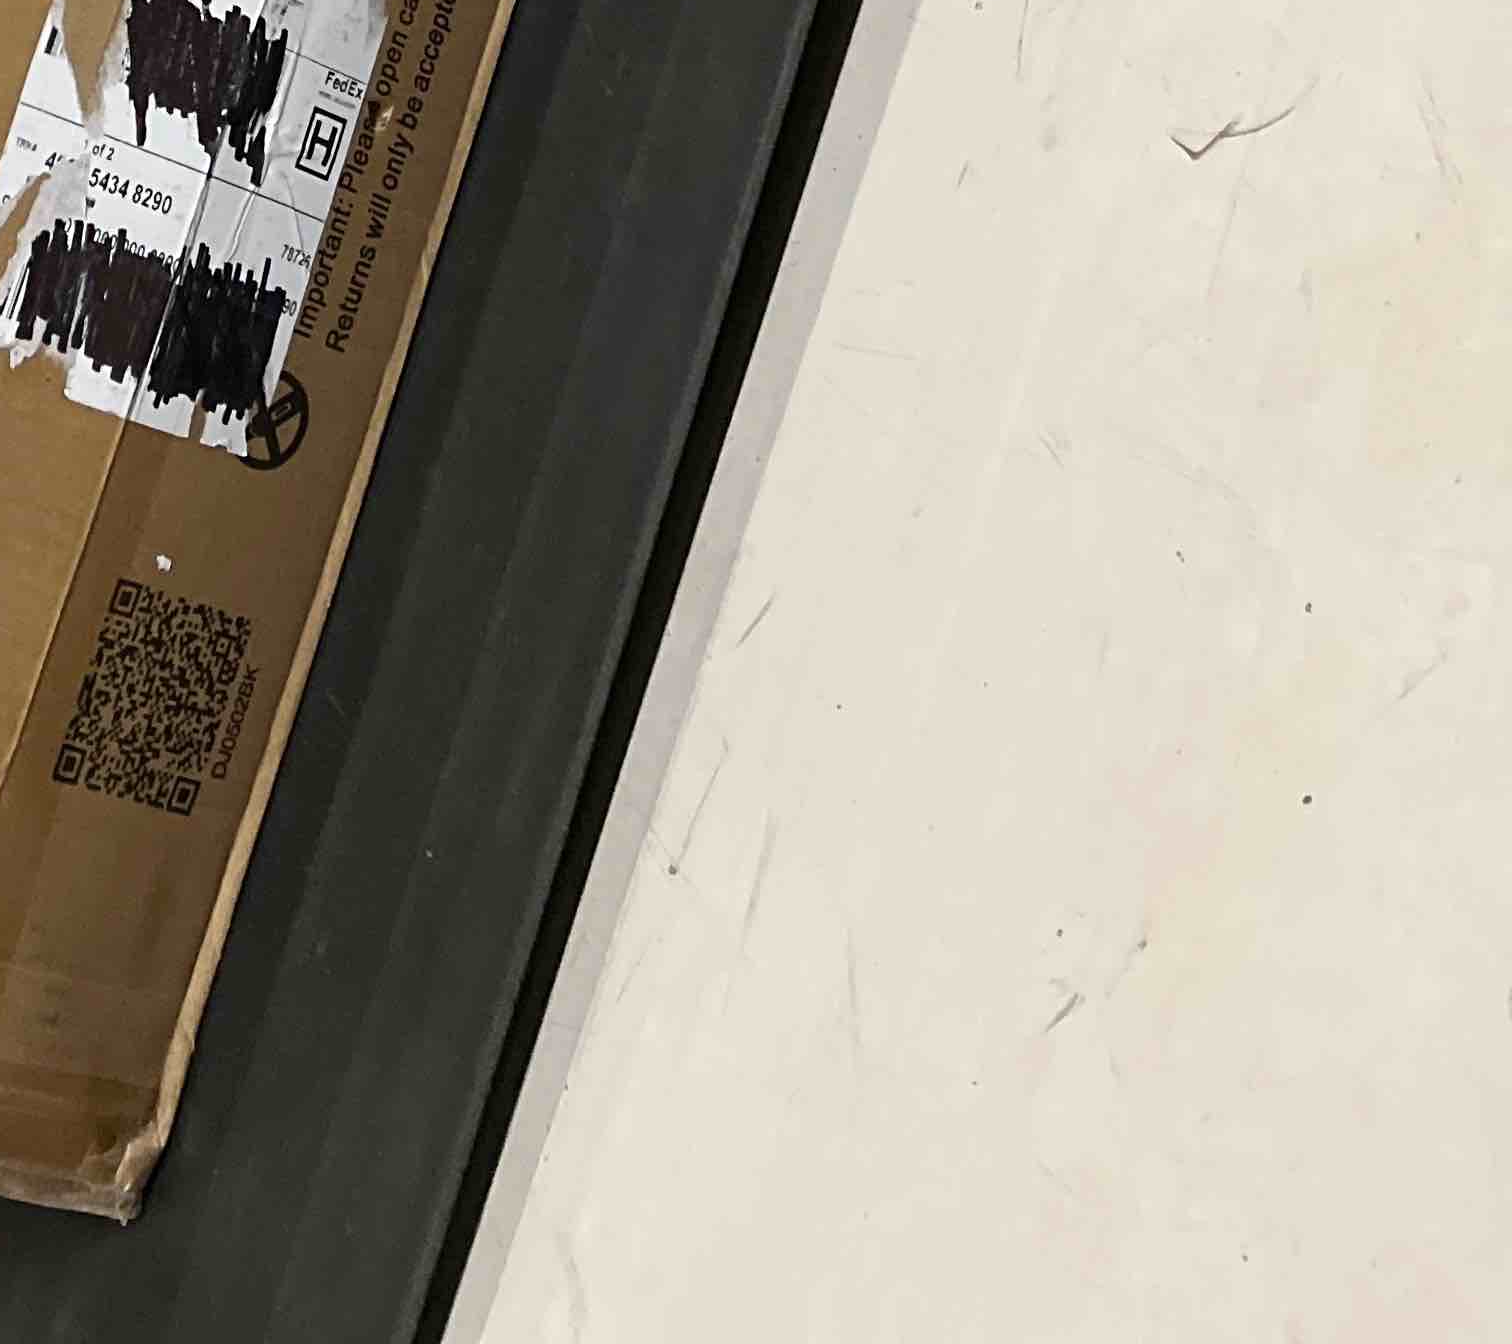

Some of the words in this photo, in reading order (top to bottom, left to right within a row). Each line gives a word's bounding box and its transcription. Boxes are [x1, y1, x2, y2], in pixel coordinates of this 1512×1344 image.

[324, 70, 365, 100] FedEx
[397, 96, 424, 131] be
[92, 143, 104, 157] of
[106, 148, 116, 162] 2
[305, 120, 338, 167] H
[382, 132, 415, 191] only
[88, 167, 131, 200] 5434
[131, 183, 173, 215] 8290
[294, 198, 355, 339] Important:
[337, 97, 382, 194] Please
[376, 30, 409, 97] open
[365, 192, 392, 239] will
[326, 245, 377, 353] Returns
